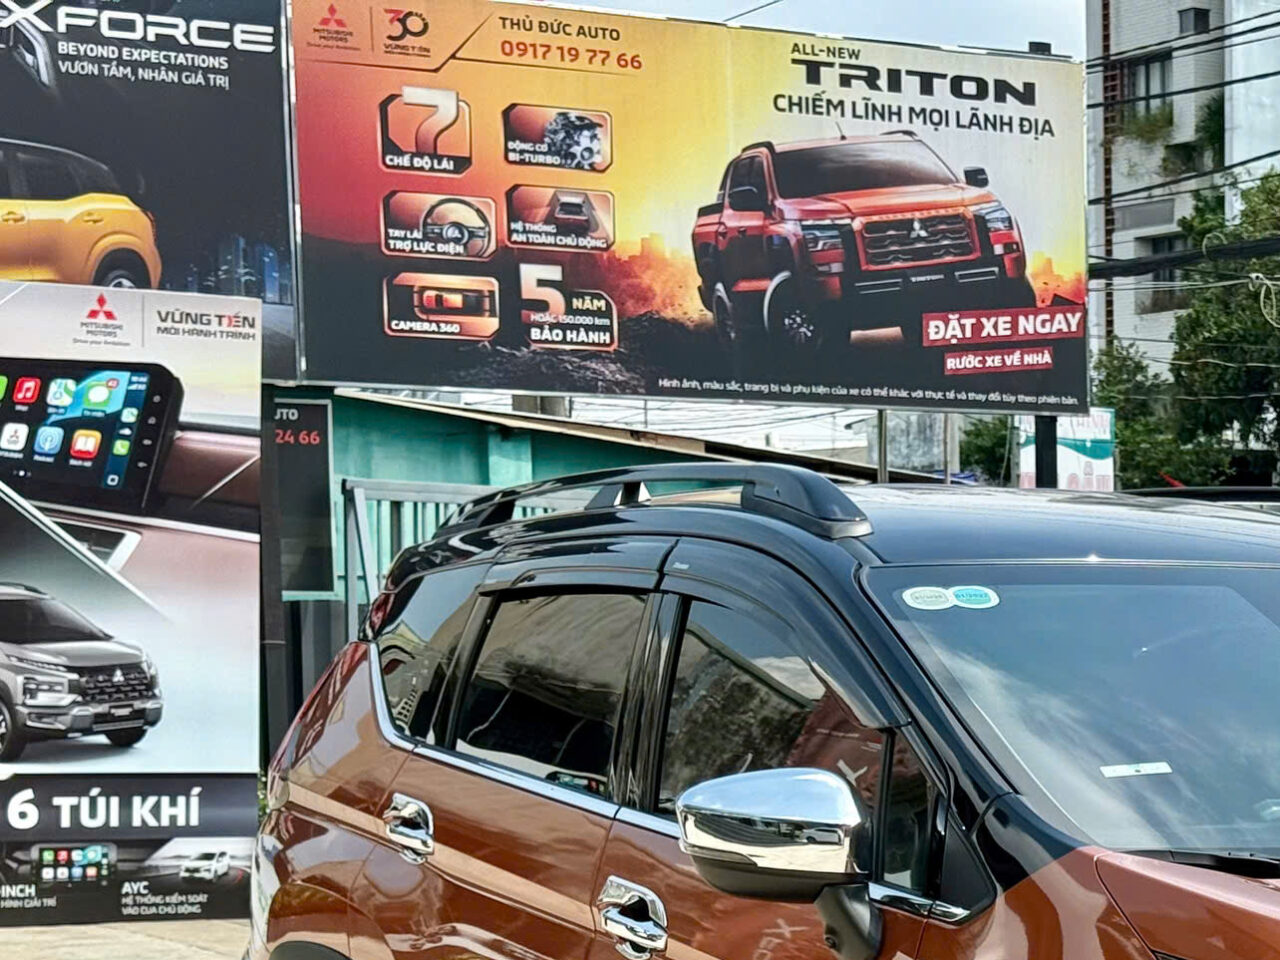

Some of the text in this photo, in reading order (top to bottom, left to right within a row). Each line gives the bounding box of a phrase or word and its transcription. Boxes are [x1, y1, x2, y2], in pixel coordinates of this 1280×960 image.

[0, 0, 275, 52] XFORCE
[498, 15, 620, 41] THỦ ĐỨC AUTO
[57, 41, 229, 69] BEYOND EXPECTATIONS
[501, 40, 642, 69] 0917 19 77 66
[791, 42, 861, 60] ALL-NEW
[58, 60, 98, 75] VƯƠN
[138, 65, 178, 83] NHÂN
[182, 70, 205, 85] GIÁ
[208, 75, 229, 91] TRỊ
[791, 58, 1036, 106] TRITON
[402, 86, 459, 154] 7
[773, 90, 1055, 141] CHIẾM LĨNH MỌI LÃNH ĐỊA
[385, 153, 454, 170] CHẾ ĐỘ LÁI
[508, 152, 561, 165] BI-TURBO
[519, 263, 566, 325] 5
[572, 295, 606, 311] NĂM
[156, 308, 256, 329] VỮNG TIẾN
[391, 320, 460, 333] CAMERA 360
[928, 312, 1083, 344] ĐẶT XE NGAY
[530, 324, 610, 344] BẢO HÀNH
[985, 355, 1002, 368] XE
[1023, 350, 1052, 366] NHÀ
[274, 429, 320, 445] 24 66
[7, 787, 202, 829] 6 TÚI KHÍ
[121, 881, 149, 894] AYC
